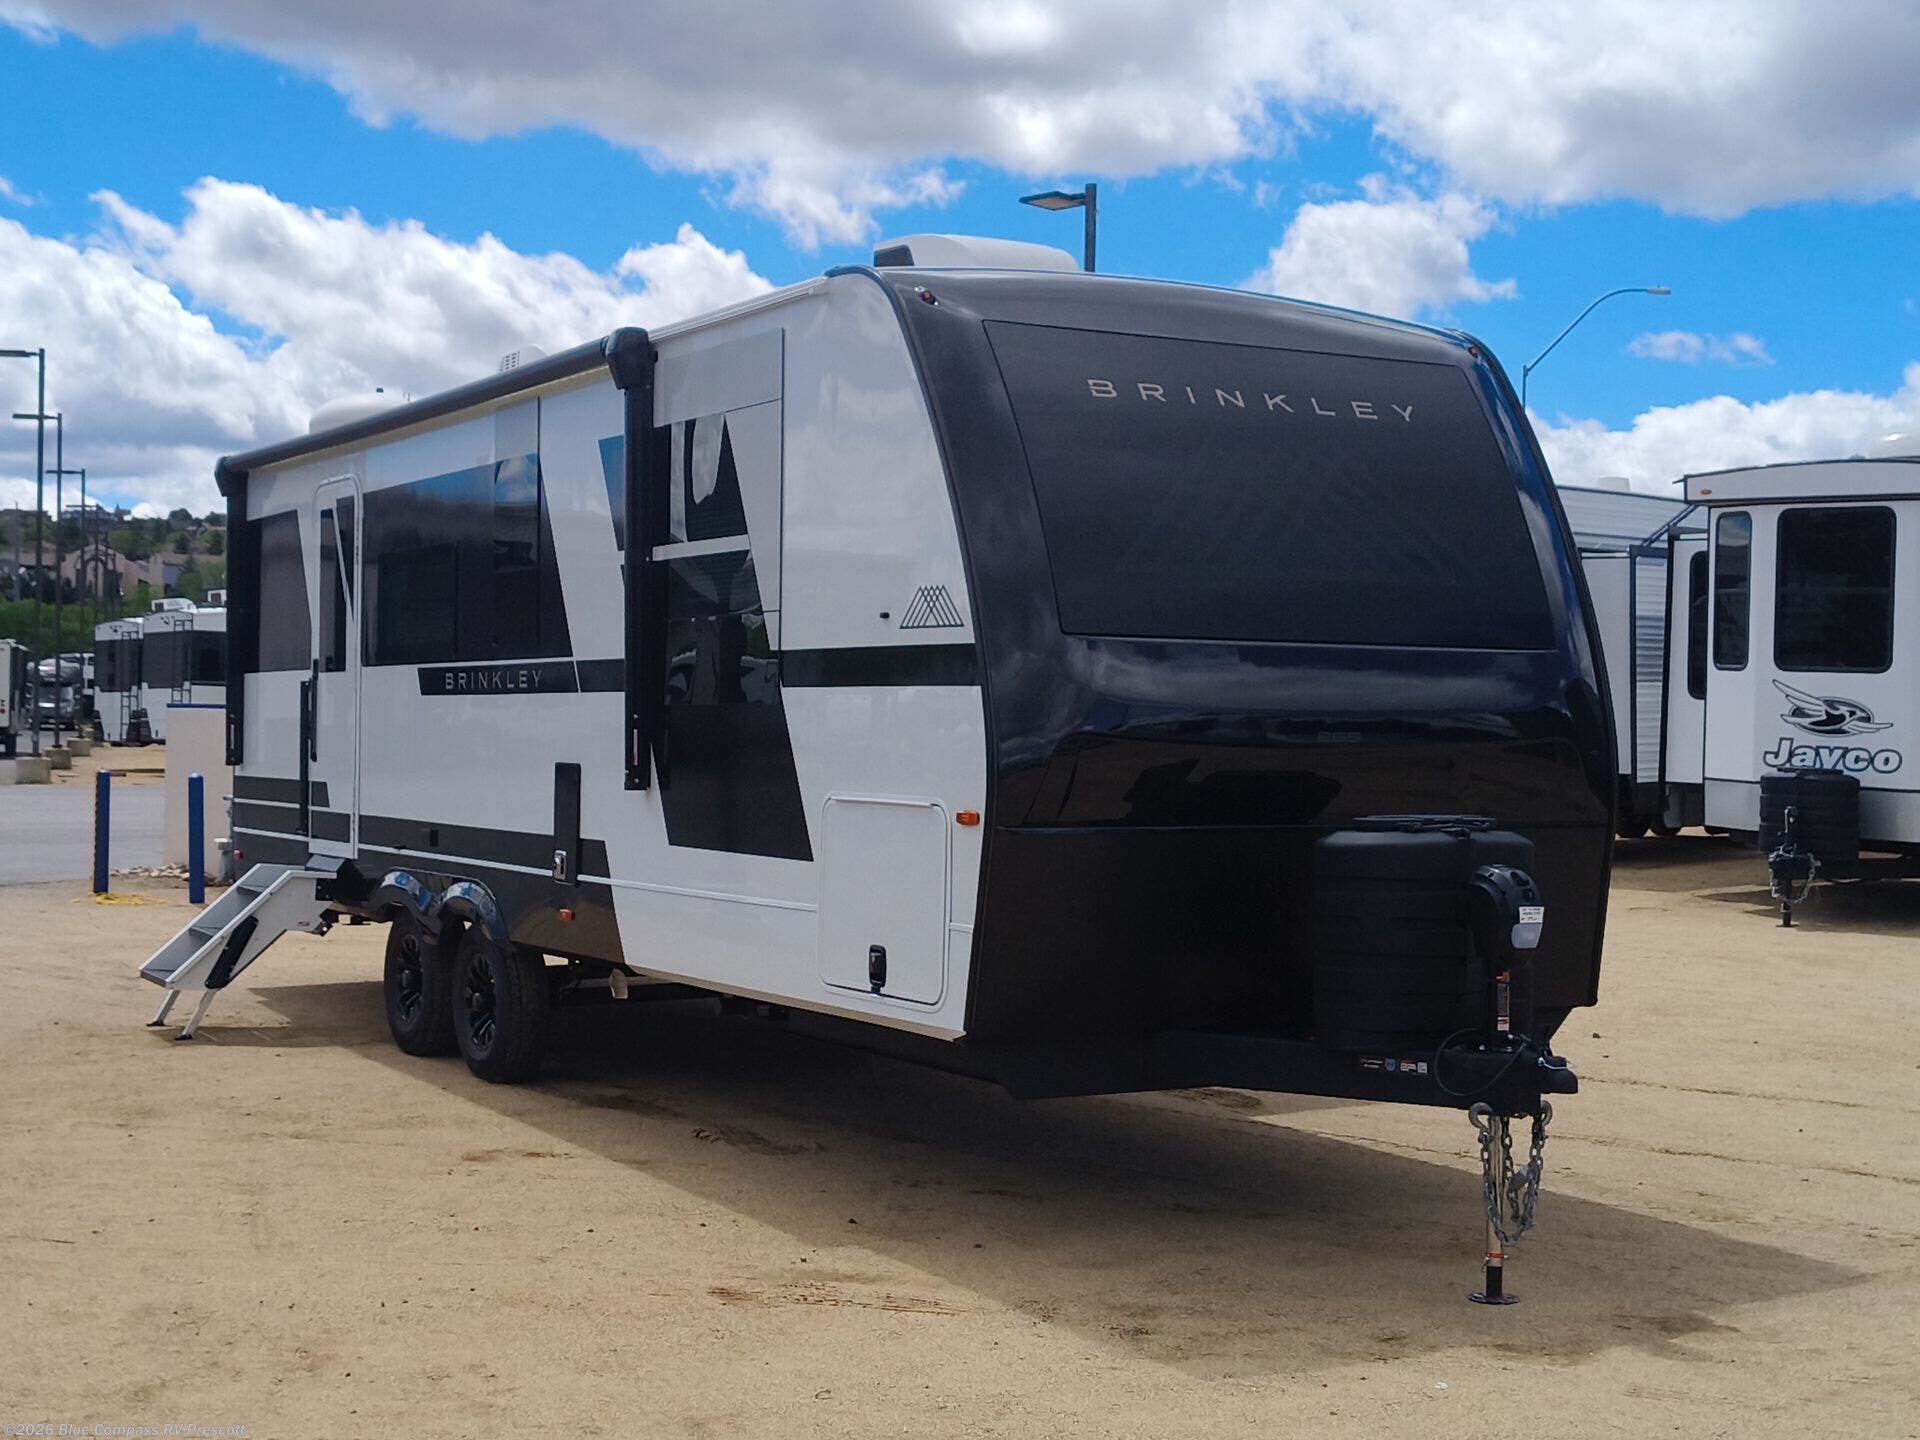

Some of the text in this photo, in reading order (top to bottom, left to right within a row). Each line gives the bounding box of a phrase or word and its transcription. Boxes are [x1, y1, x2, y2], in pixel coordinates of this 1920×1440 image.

[1086, 378, 1414, 422] BRINKLEY
[445, 670, 542, 690] BRINKLEY
[1763, 737, 1903, 774] Jayco
